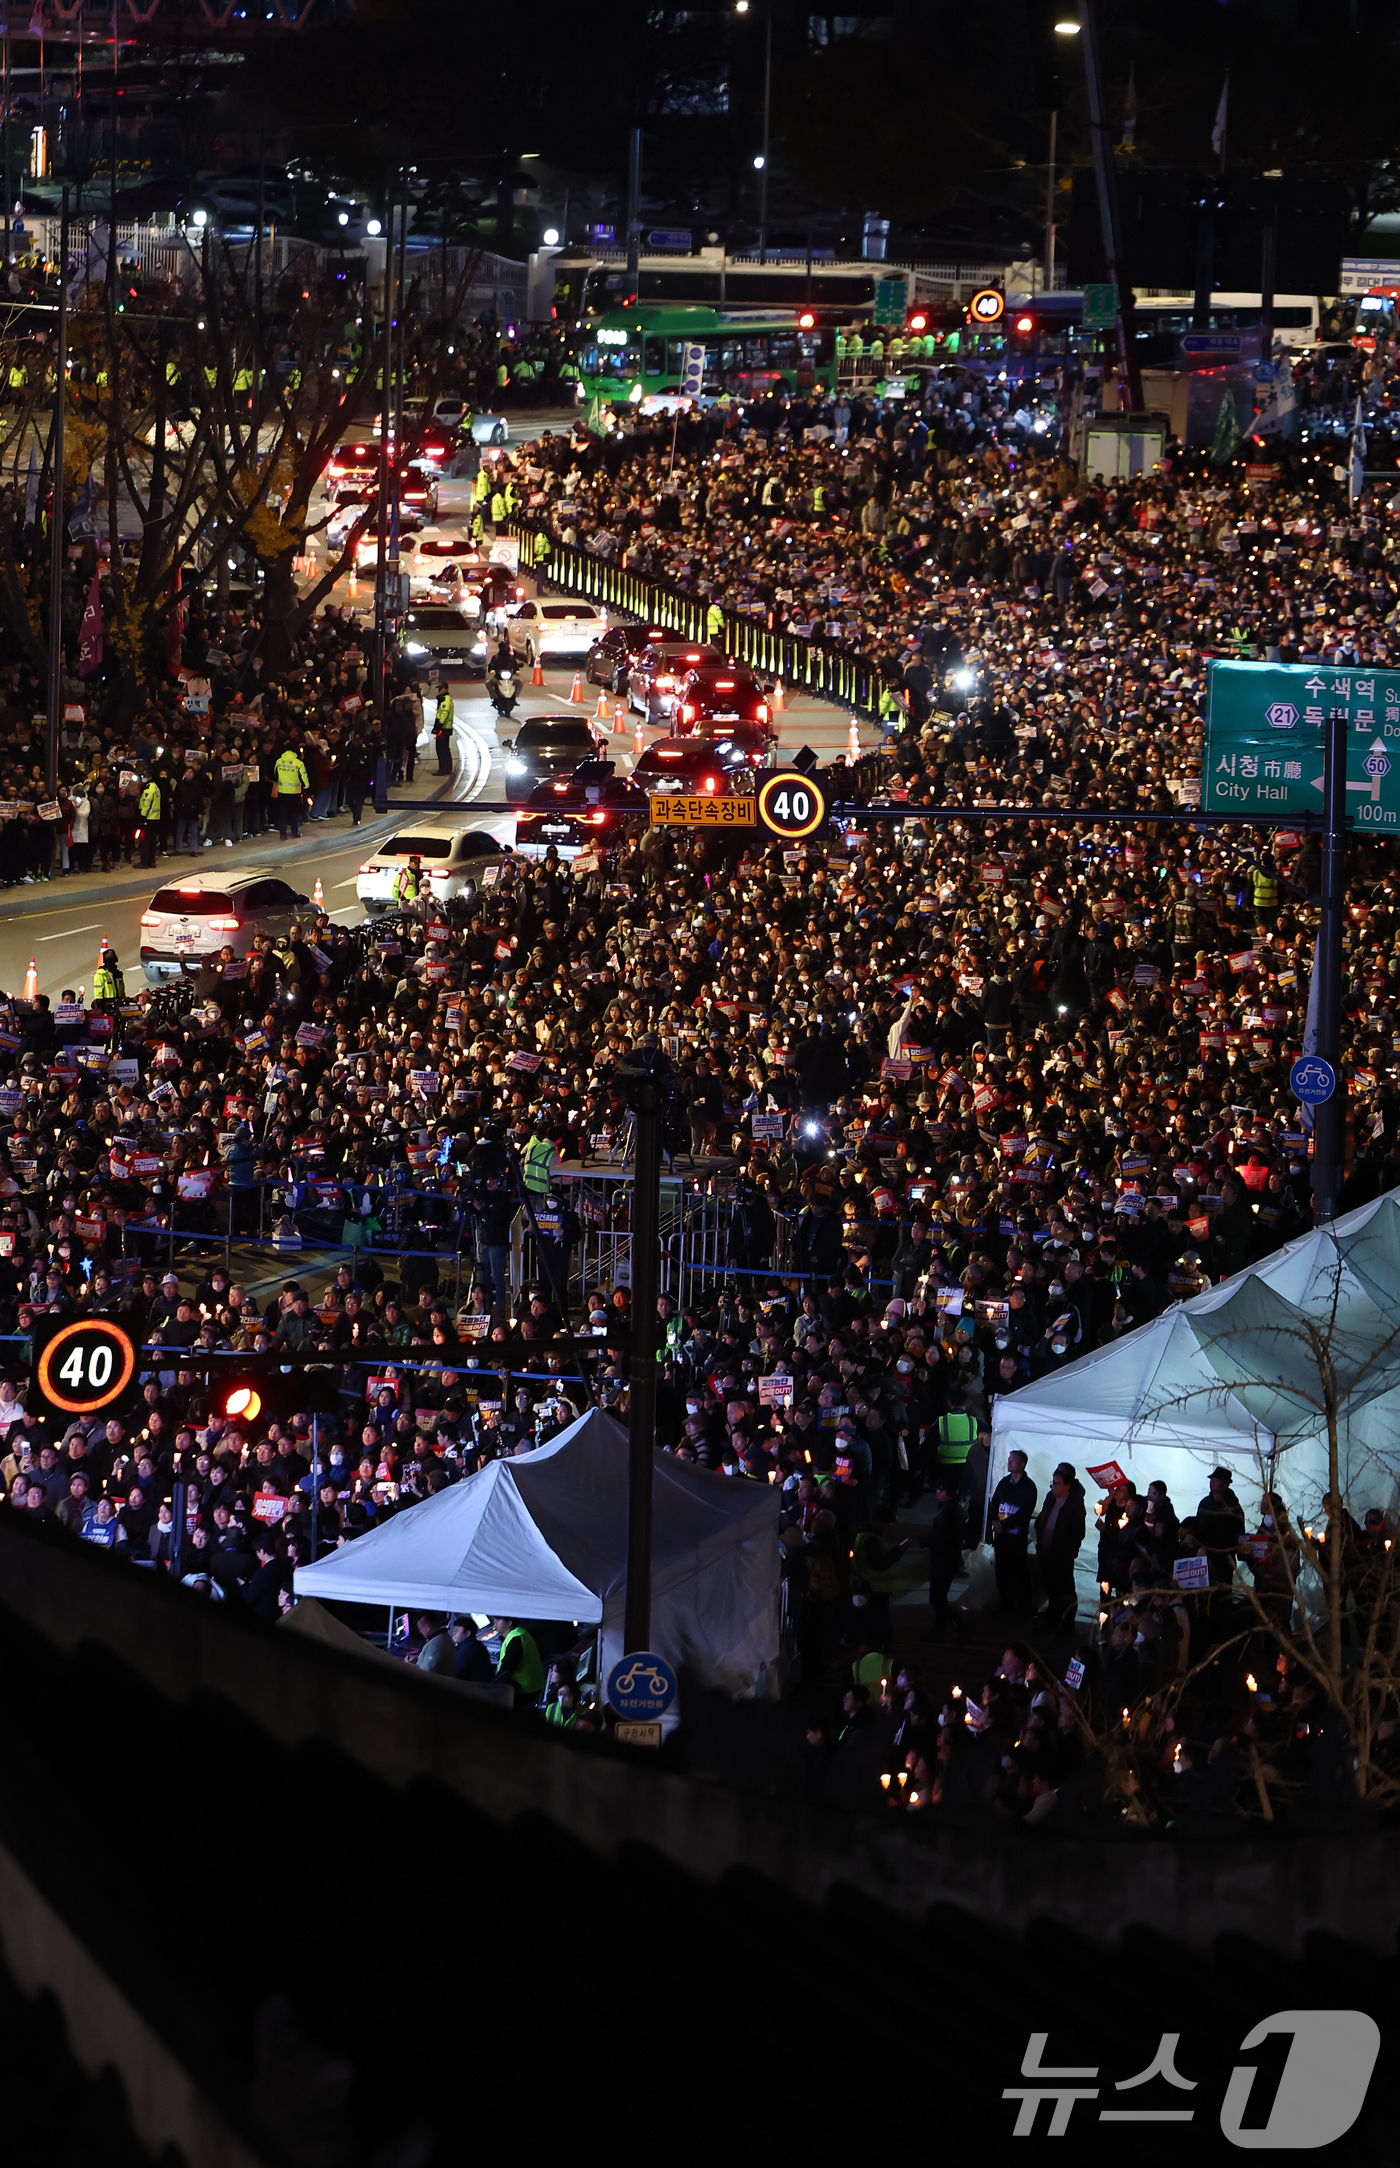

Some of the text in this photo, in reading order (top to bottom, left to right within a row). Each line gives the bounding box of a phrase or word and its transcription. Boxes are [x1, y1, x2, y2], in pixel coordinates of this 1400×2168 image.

[977, 298, 997, 315] 40
[1304, 676, 1376, 702] 수색역
[1274, 707, 1291, 723] 21
[1216, 754, 1302, 780] 시청 市廳
[1368, 759, 1384, 773] 50
[1215, 782, 1288, 801] City Hall
[655, 799, 751, 821] 과속단속장비
[774, 791, 809, 821] 40
[1357, 805, 1397, 822] 100m
[1298, 1088, 1327, 1096] 자전거전용
[59, 1345, 112, 1388] 40
[1190, 1567, 1206, 1576] OUT!
[620, 1699, 664, 1709] 자전거전용
[623, 1728, 654, 1738] 구간시작
